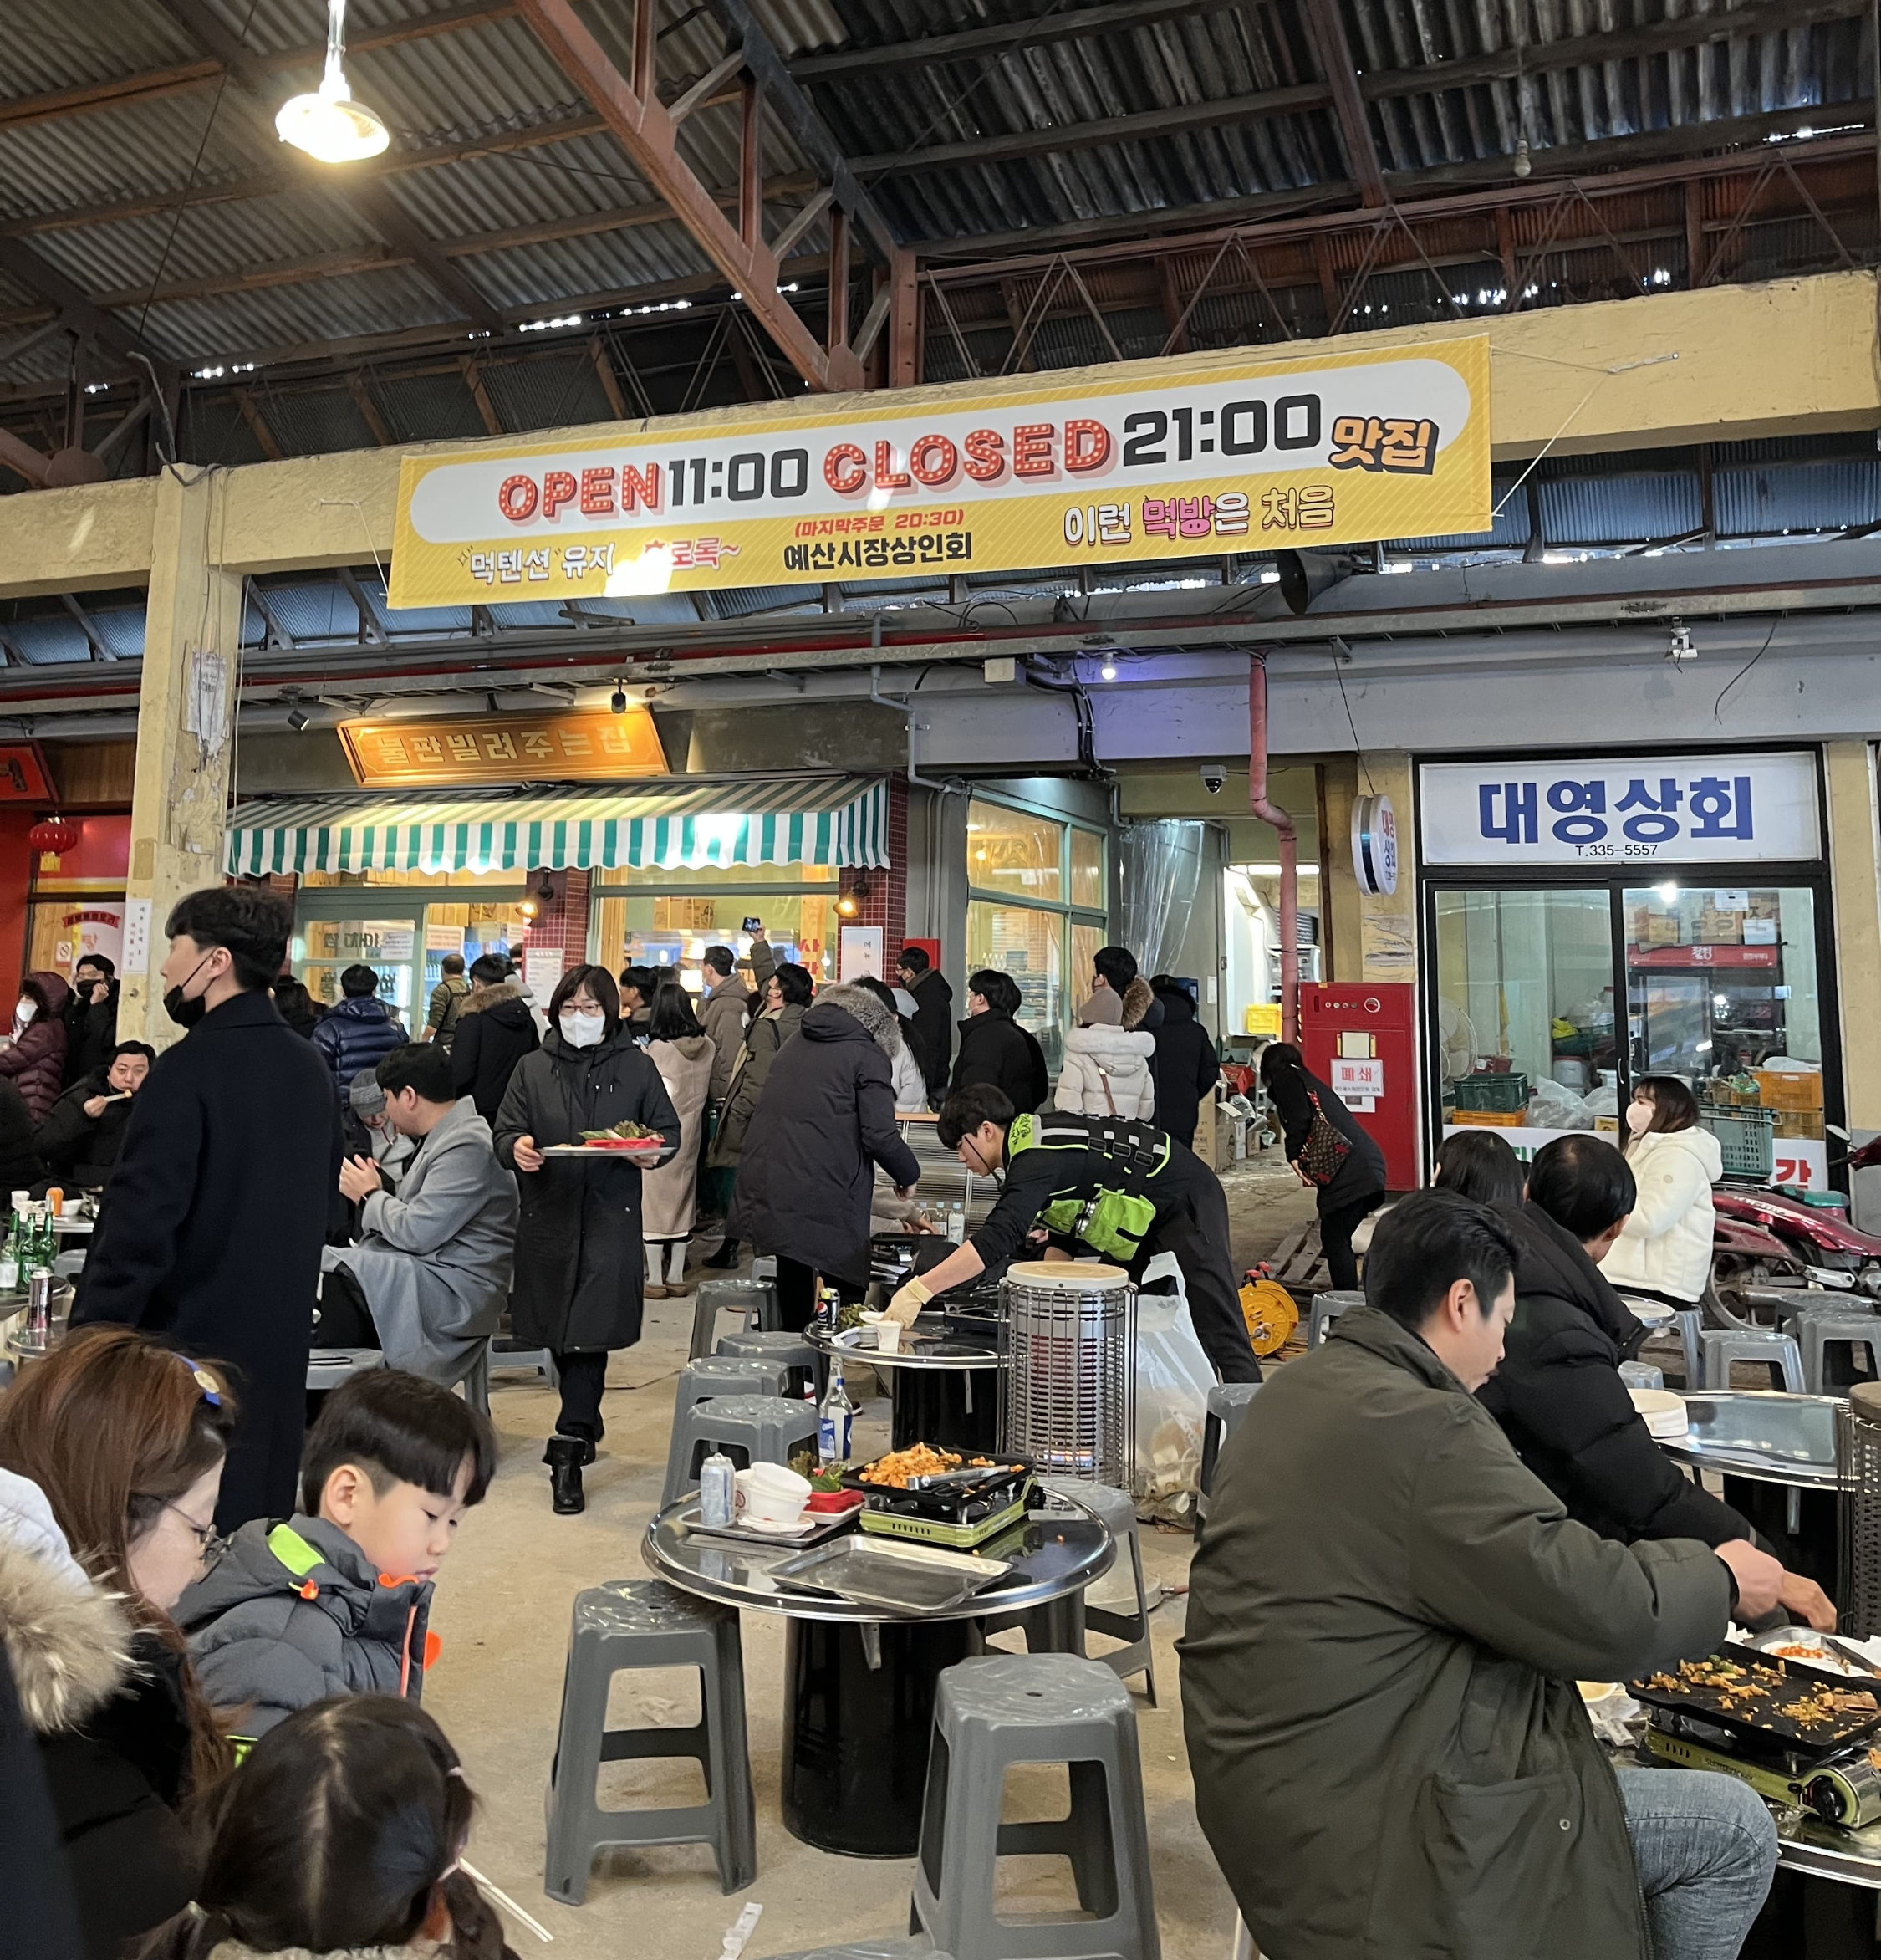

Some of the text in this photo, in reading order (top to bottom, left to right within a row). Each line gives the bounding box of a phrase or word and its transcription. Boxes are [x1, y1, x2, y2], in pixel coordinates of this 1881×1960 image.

[498, 393, 1321, 522] OPEN 11:00 CLOSED 21:00
[1328, 416, 1440, 475] 맛집
[895, 509, 965, 530] 20:30)
[1063, 485, 1335, 547] 이런 먹방은 처음
[561, 542, 616, 578] 유지
[783, 531, 972, 571] 예산시장상인회
[1479, 777, 1753, 844] 대영상회
[1575, 844, 1658, 857] T.335-5557
